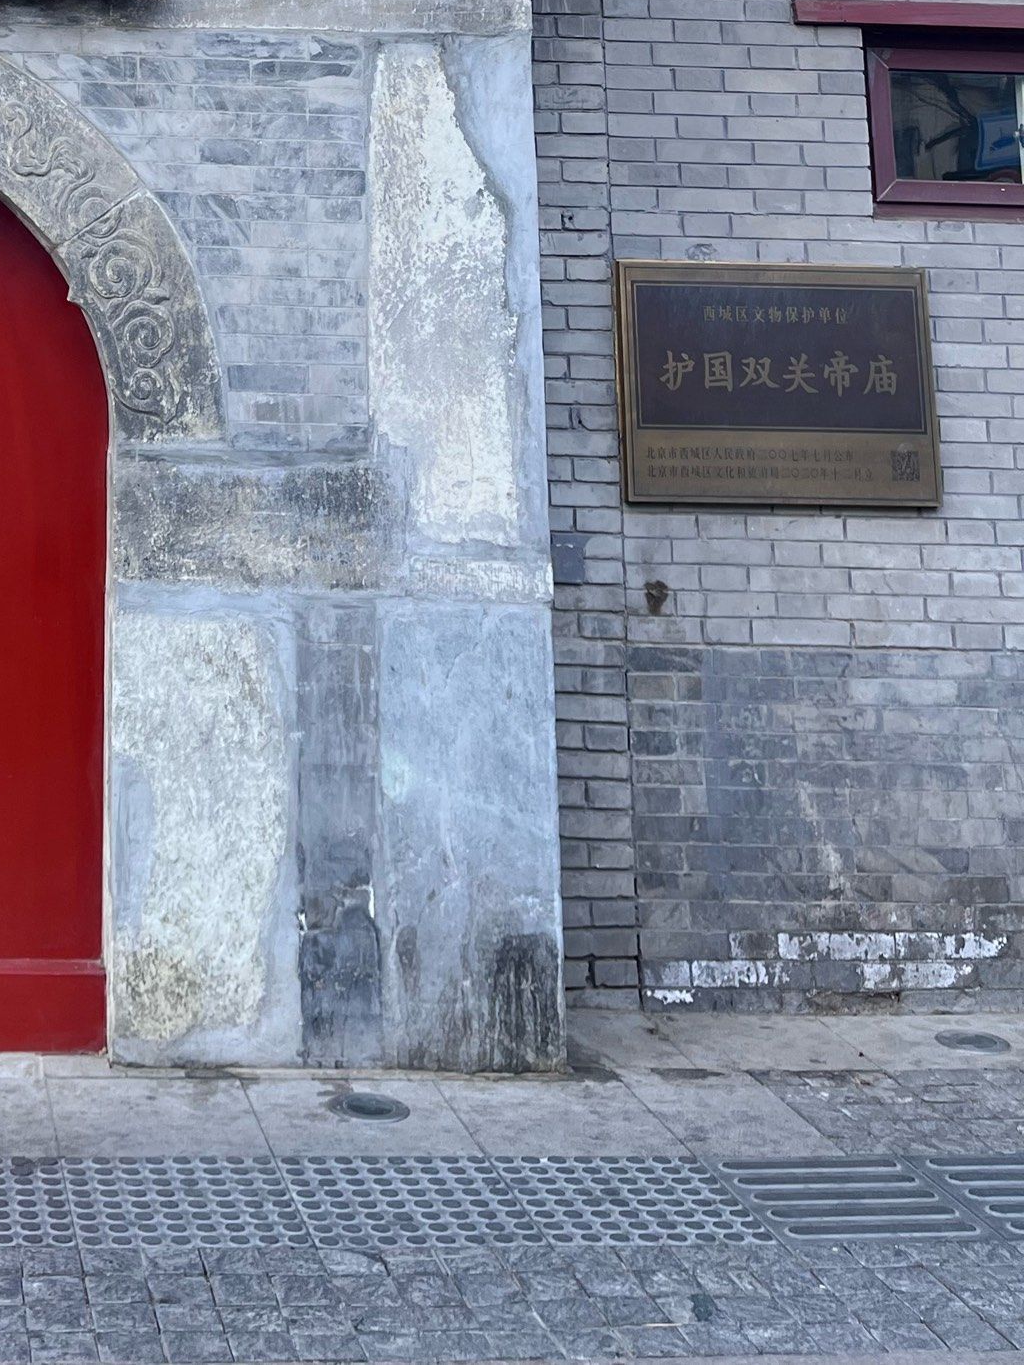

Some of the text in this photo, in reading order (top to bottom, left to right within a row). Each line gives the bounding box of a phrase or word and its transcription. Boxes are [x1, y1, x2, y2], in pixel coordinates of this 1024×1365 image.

[703, 305, 849, 324] 西城区文物保护单位
[659, 349, 898, 398] 护国双关帝庙
